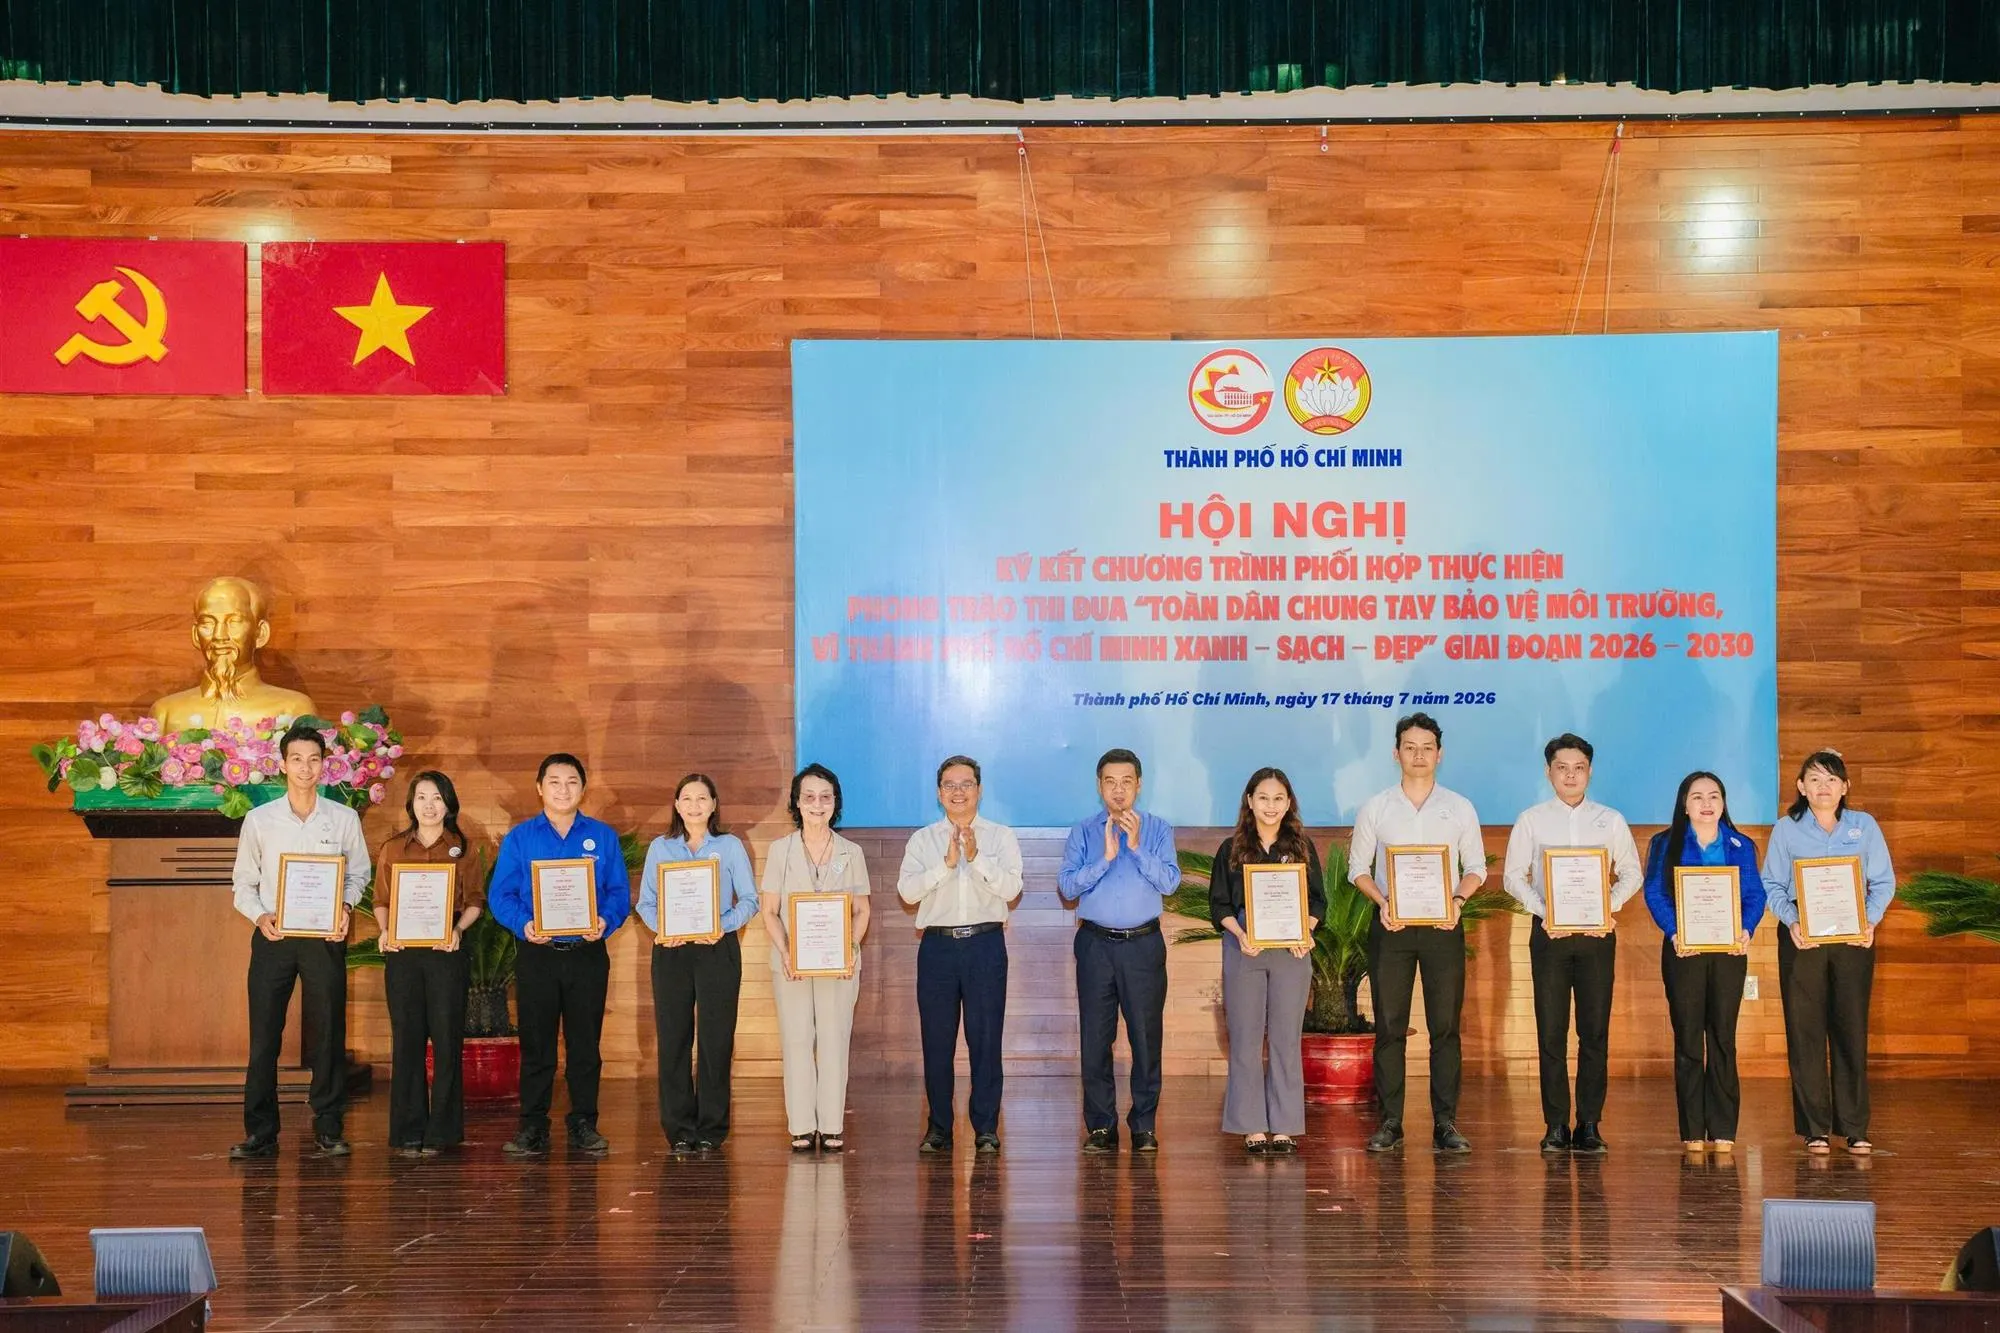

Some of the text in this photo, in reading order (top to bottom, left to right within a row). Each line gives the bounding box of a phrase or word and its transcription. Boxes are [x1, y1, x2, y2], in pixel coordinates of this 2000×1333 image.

[1164, 443, 1402, 468] THÀNH PHỐ HỒ CHÍ MINH
[1160, 493, 1406, 546] HỘI NGHỊ
[997, 547, 1563, 583] KÝ KẾT CHƯƠNG TRÌNH PHỐI HỢP THỰC HIỆN
[1023, 596, 1065, 621] THI
[1072, 595, 1128, 621] ĐUA
[1226, 590, 1280, 621] DÂN
[1287, 595, 1378, 621] CHUNG
[1384, 594, 1436, 621] TAY
[1443, 588, 1499, 620] BẢO
[1505, 588, 1539, 622] VỆ
[1546, 588, 1599, 619] MÔI
[1606, 588, 1724, 620] TRƯỜNG,
[1050, 631, 1094, 662] CHÍ
[1100, 635, 1167, 661] MINH
[1174, 635, 1248, 661] XANH
[1276, 634, 1345, 664] SẠCH
[1444, 634, 1499, 660] GIAI
[1506, 633, 1582, 662] ĐOẠN
[1589, 633, 1658, 660] 2026
[1686, 632, 1754, 660] 2030
[1073, 691, 1496, 709] Thành phố Hồ Chí Minh, ngày 17 tháng 7 năm 2026
